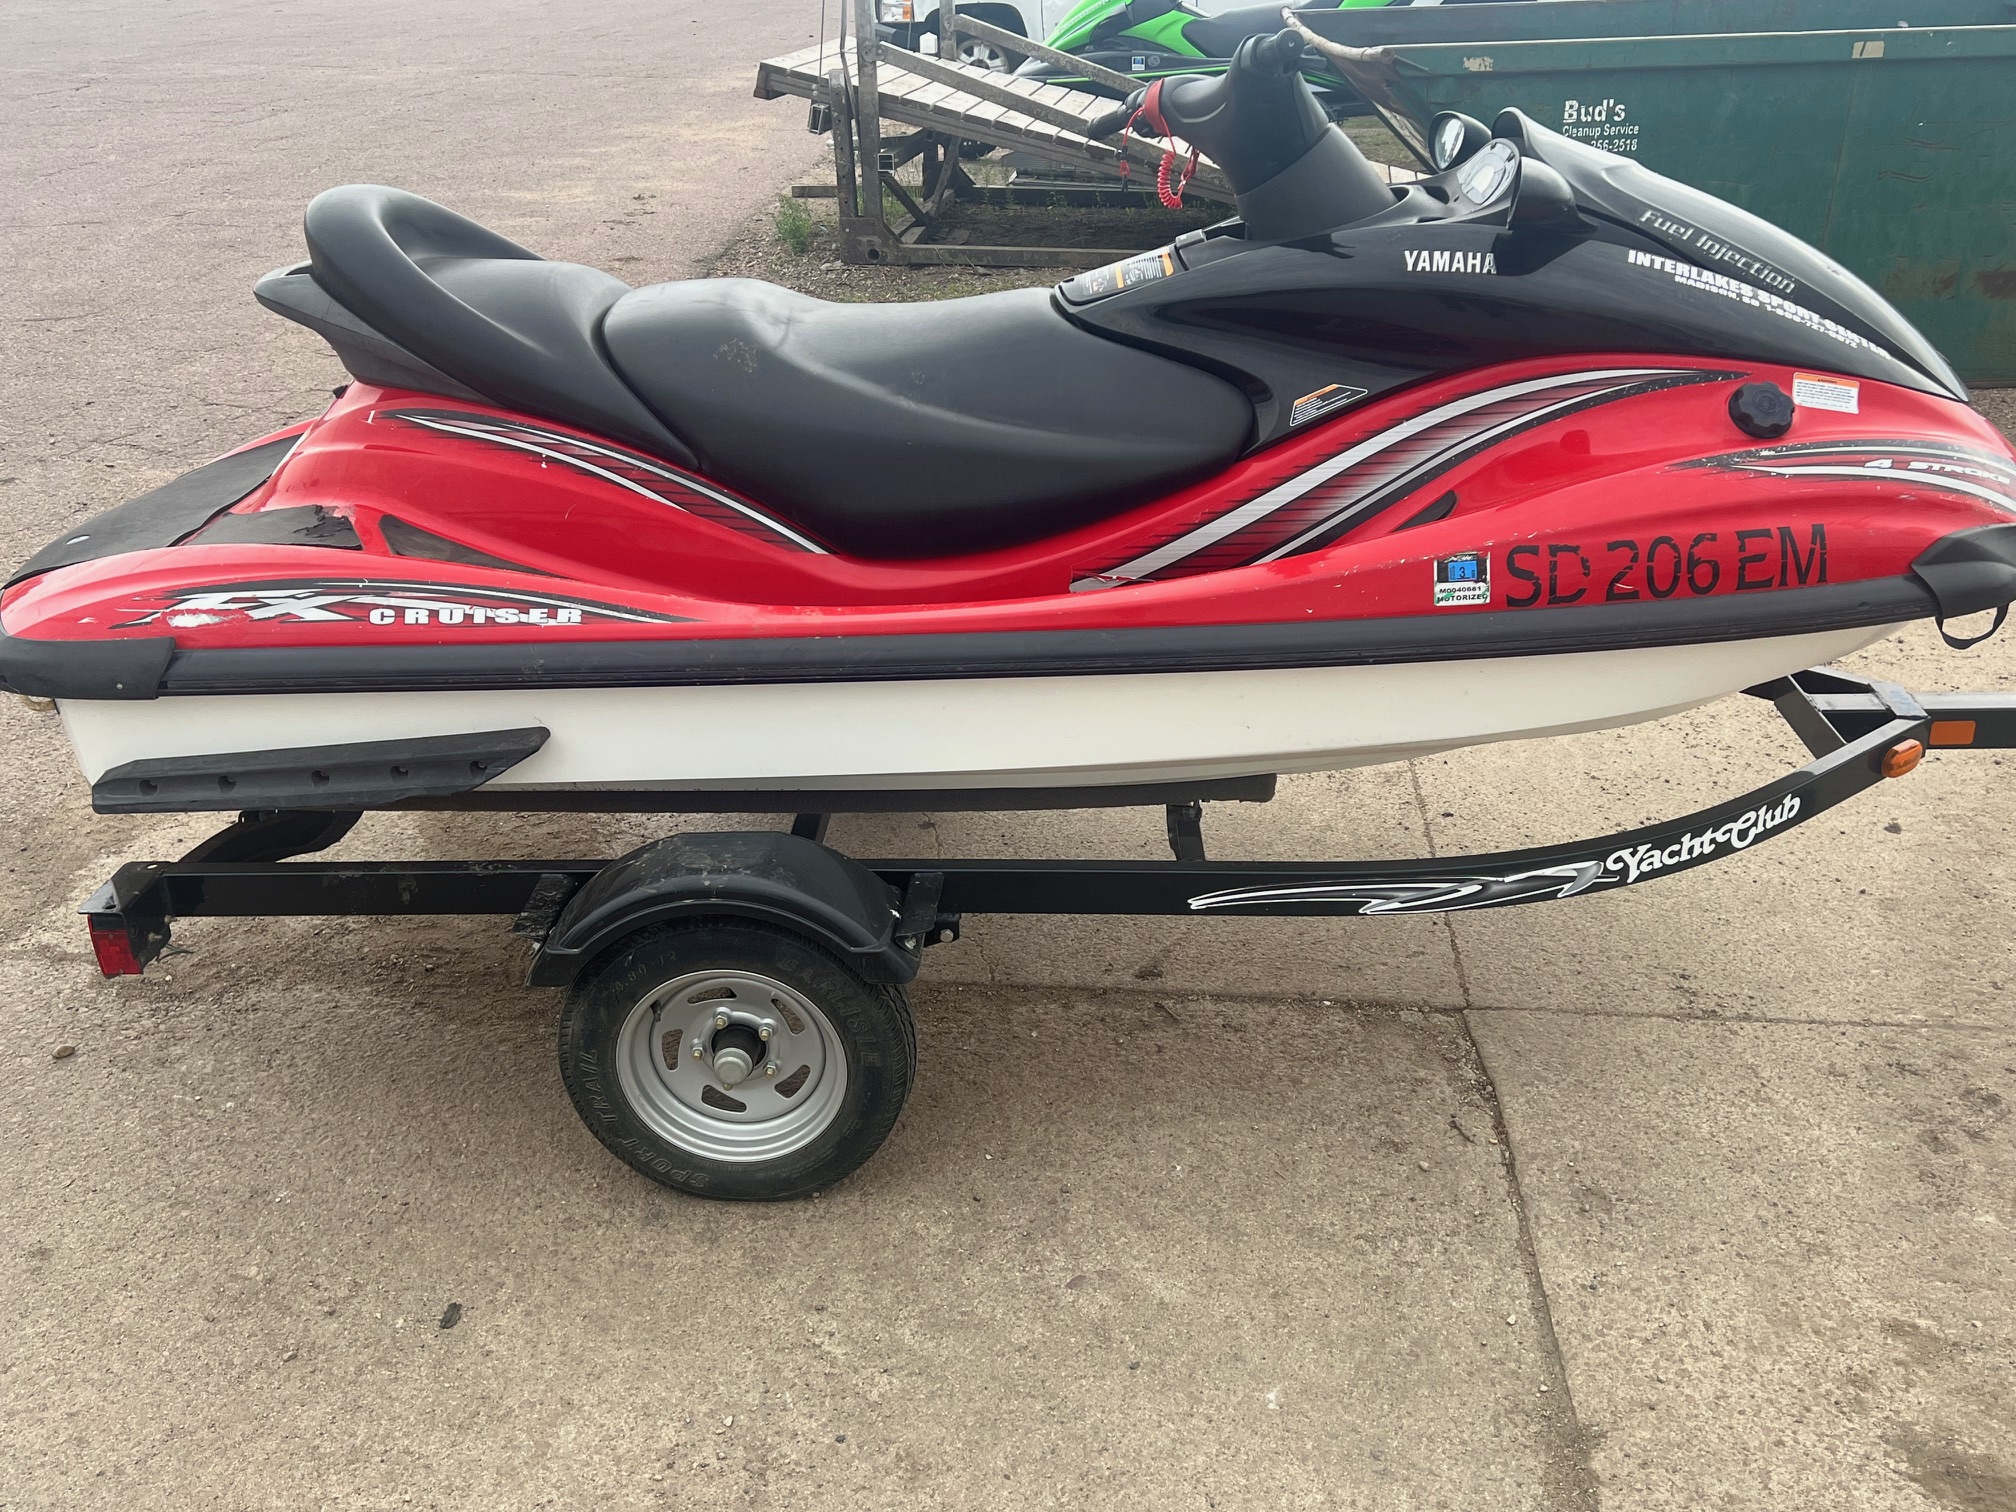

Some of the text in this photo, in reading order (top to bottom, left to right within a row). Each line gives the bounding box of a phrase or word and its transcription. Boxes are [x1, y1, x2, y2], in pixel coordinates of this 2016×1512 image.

[1563, 99, 1626, 123] Bud's
[1562, 123, 1640, 139] Cleanup Service
[1404, 250, 1497, 274] YAMAHA
[1639, 208, 1796, 294] Fuel Injection
[1627, 249, 1754, 298] INTERLAKES
[1757, 288, 1820, 323] SPORT
[1674, 275, 1740, 301] MADISON,
[1864, 458, 2011, 485] 4 STROKE
[1505, 522, 1829, 608] SD 206 EM
[368, 607, 584, 626] CRUISER
[776, 957, 882, 1067] CARLISLE
[579, 1049, 712, 1188] SPORT TRAIL
